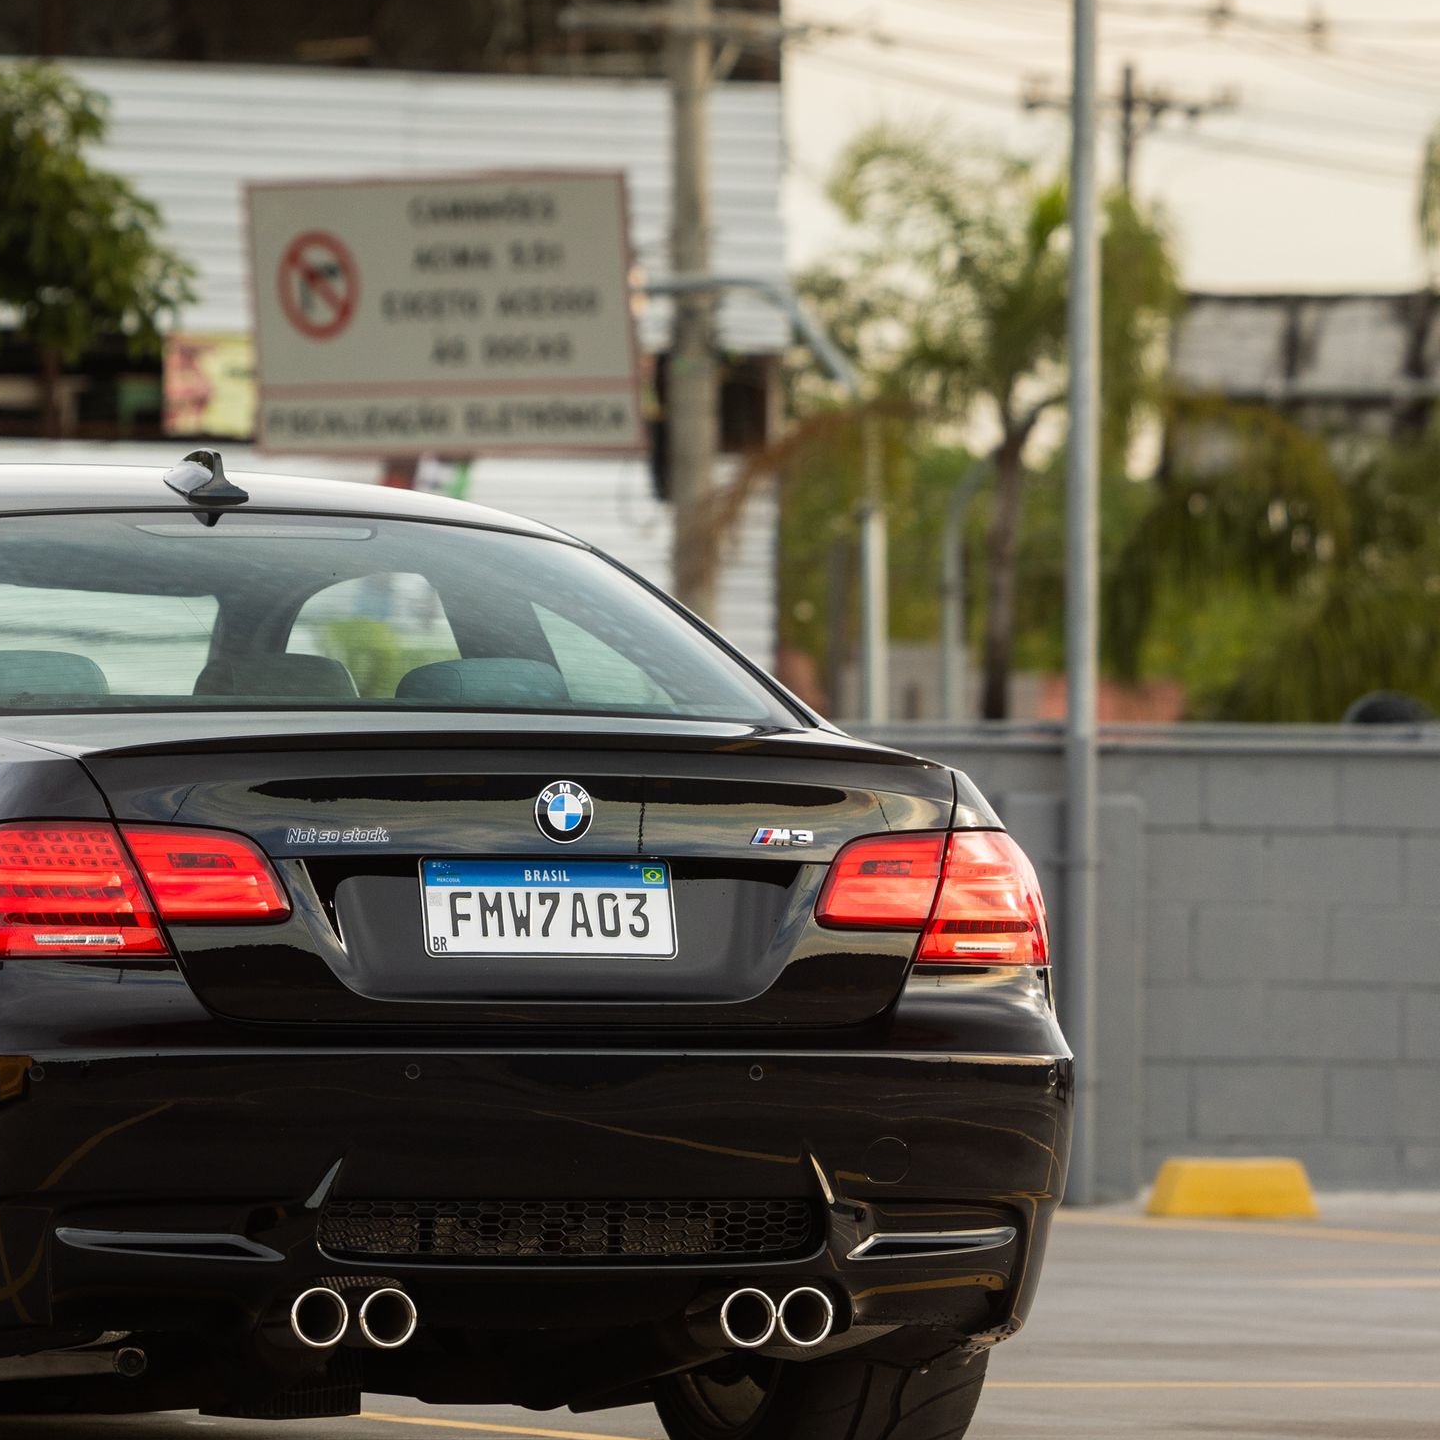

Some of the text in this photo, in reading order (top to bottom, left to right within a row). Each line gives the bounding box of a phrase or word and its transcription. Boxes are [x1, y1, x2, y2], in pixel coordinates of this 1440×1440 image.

[381, 284, 599, 321] EXCETO ACESSO
[267, 397, 626, 436] FISCALIZAÇÃO ELETRÔNICA
[541, 783, 589, 804] BMW
[287, 827, 389, 843] Not so stock.
[763, 828, 814, 846] M3
[524, 869, 570, 882] BRASIL
[449, 891, 650, 938] FMW7A03
[432, 936, 448, 952] BR
